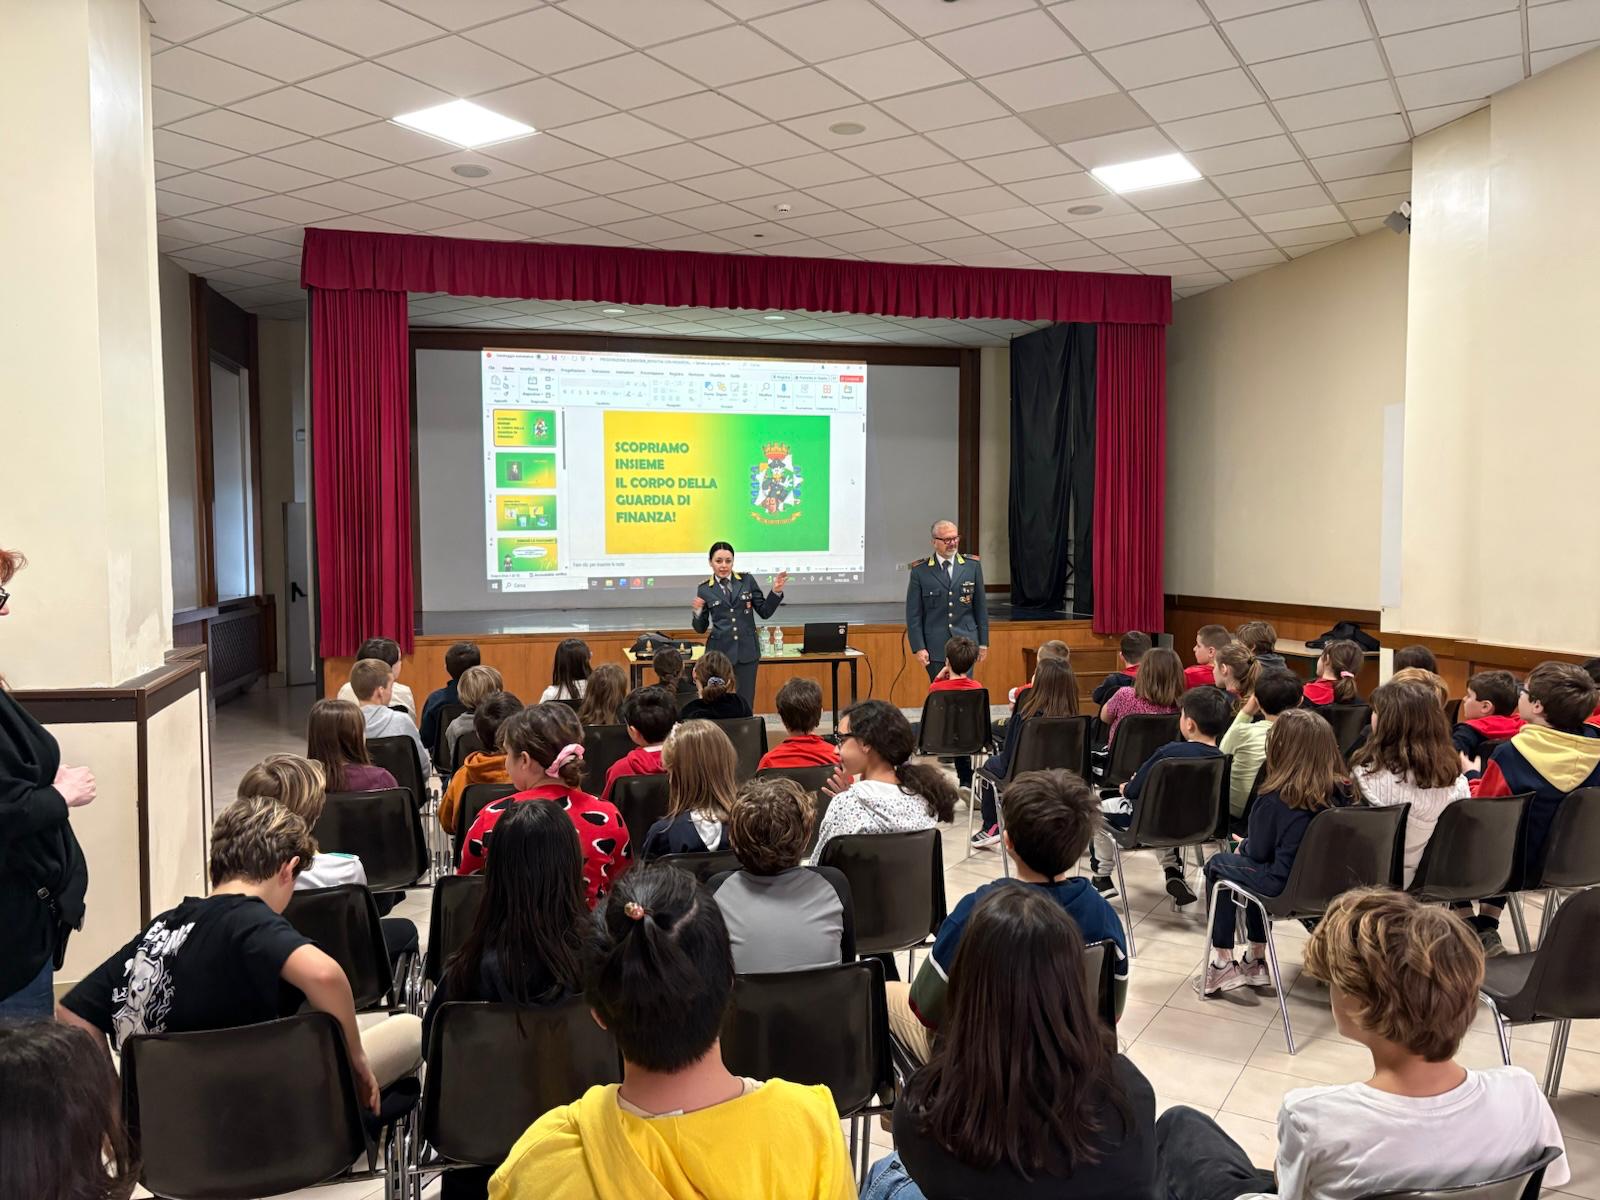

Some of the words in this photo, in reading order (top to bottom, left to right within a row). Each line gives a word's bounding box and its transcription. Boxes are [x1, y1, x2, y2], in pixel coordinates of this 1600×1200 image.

[615, 441, 690, 454] SCOPRIAMO
[615, 458, 665, 470] INSIEME
[615, 477, 627, 489] IL
[630, 477, 676, 489] CORPO
[678, 478, 718, 489] DELLA
[615, 494, 674, 506] GUARDIA
[677, 494, 691, 506] DI
[616, 511, 676, 523] FINANZA!
